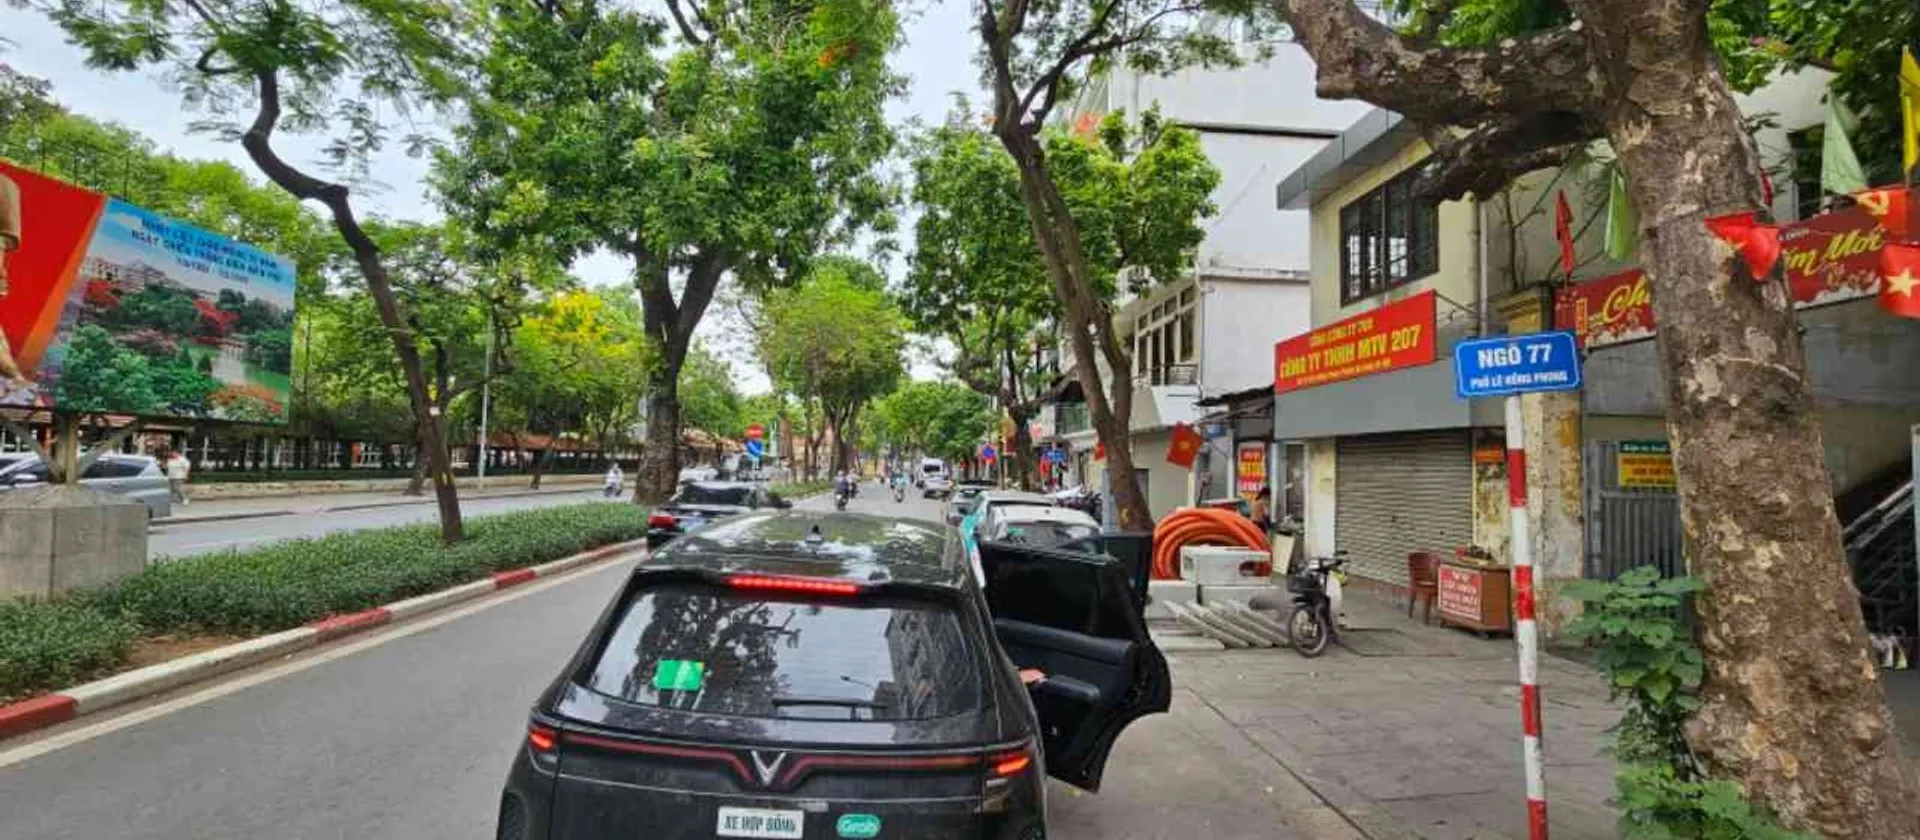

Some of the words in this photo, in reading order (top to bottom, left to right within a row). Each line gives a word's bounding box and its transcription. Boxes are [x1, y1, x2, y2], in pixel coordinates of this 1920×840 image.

[1280, 356, 1306, 379] CÔNG
[1308, 352, 1321, 371] TY
[1323, 342, 1355, 368] TNHH
[1357, 332, 1388, 360] MTV
[1391, 324, 1421, 352] 207
[1477, 344, 1521, 369] NGÕ
[1526, 344, 1552, 364] 77
[1534, 371, 1568, 383] PHONG
[724, 816, 739, 829] XE
